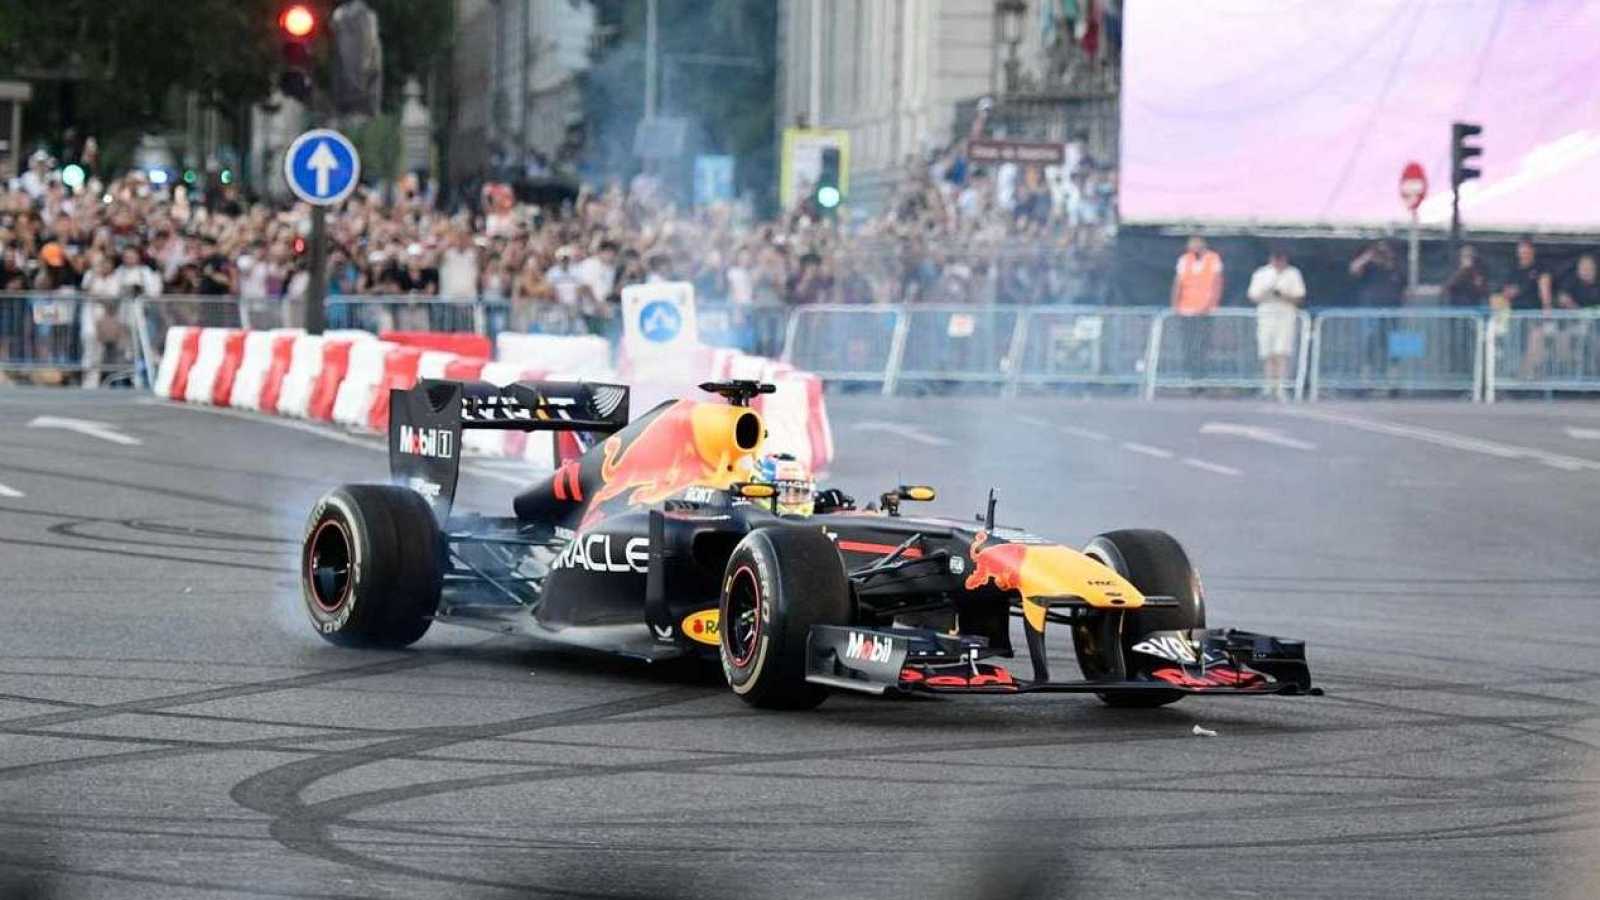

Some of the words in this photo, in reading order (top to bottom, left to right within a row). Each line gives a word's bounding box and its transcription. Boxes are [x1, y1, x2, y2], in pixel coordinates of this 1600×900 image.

[400, 424, 436, 457] Mobil
[438, 430, 452, 458] 1
[552, 533, 650, 573] RACLE
[846, 631, 892, 663] Mobil
